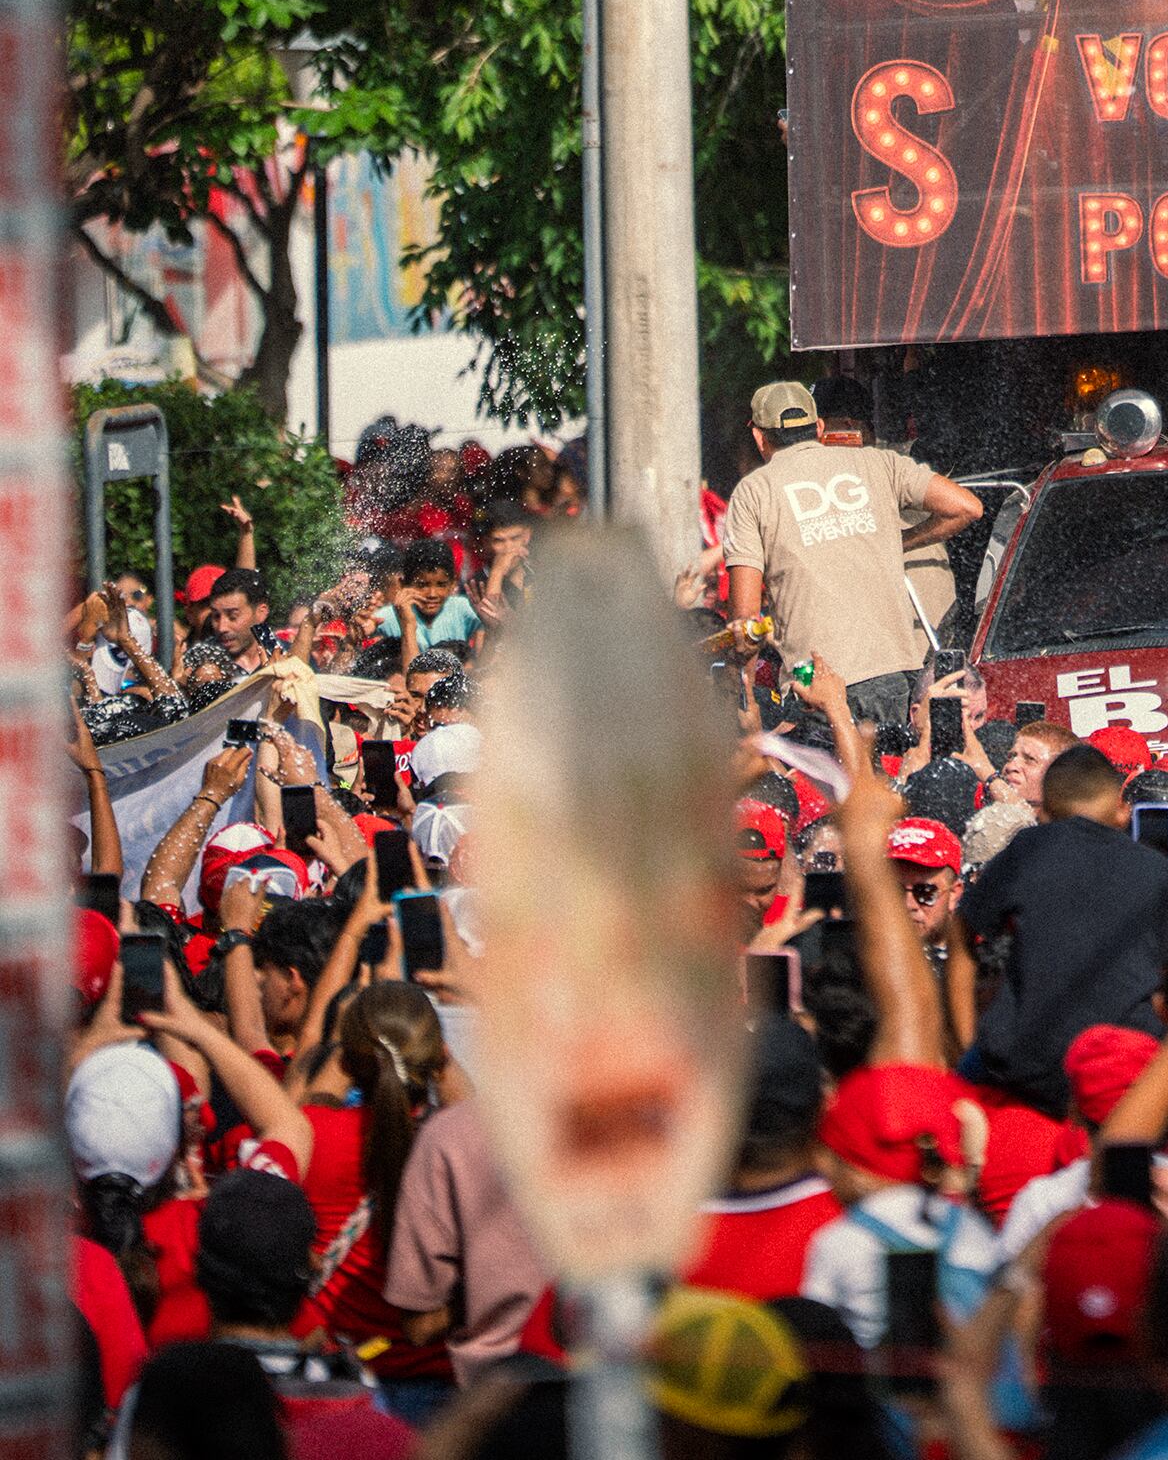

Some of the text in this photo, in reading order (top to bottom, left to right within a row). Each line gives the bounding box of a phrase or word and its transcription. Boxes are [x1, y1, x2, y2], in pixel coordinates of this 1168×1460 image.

[851, 59, 959, 248] S
[784, 472, 870, 523] DG
[801, 519, 877, 547] EVENTOS
[1056, 665, 1158, 698] EL
